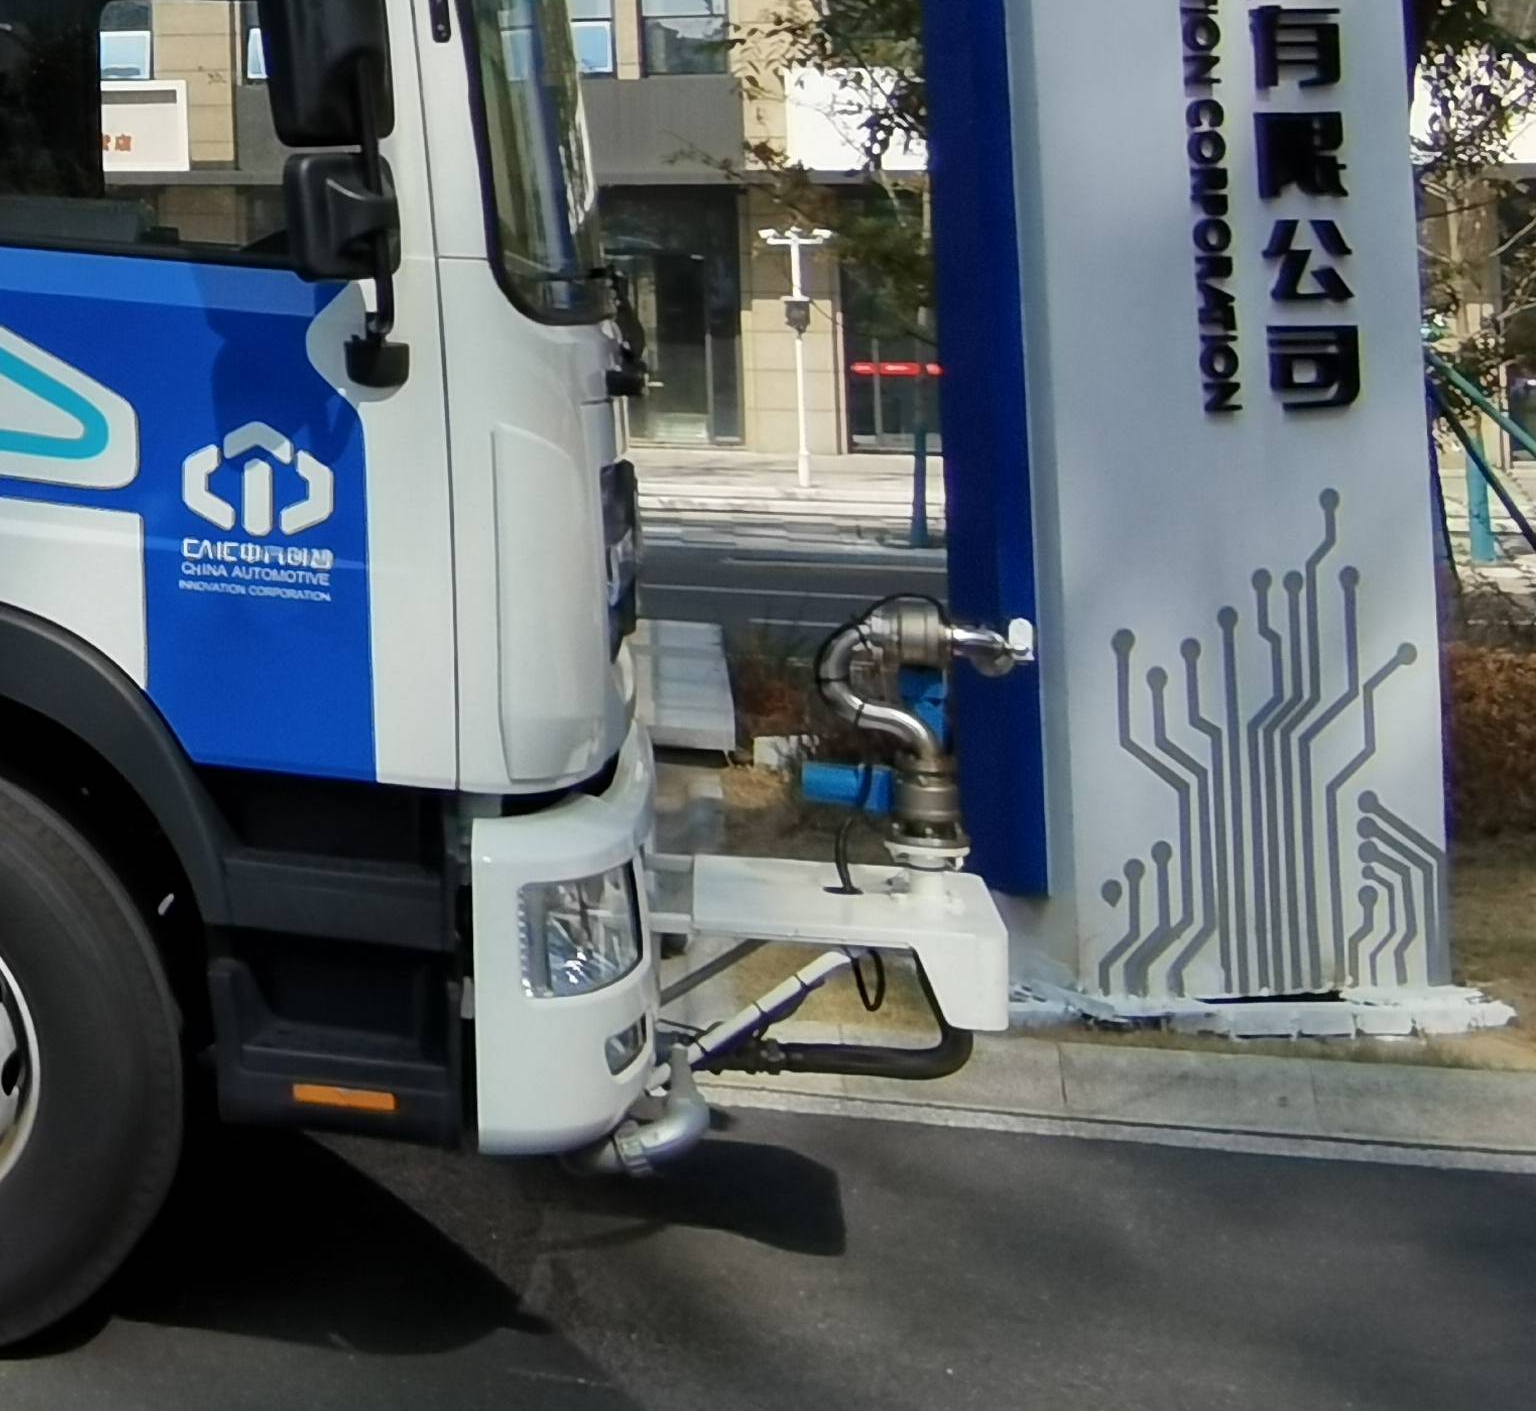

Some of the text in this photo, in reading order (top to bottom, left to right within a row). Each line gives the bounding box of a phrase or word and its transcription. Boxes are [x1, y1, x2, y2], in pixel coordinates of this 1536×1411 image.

[1185, 99, 1243, 412] CORPORATION
[181, 561, 331, 586] CHINA AUTOMOTIVE
[178, 579, 331, 602] INNOVATION CORPORATION
